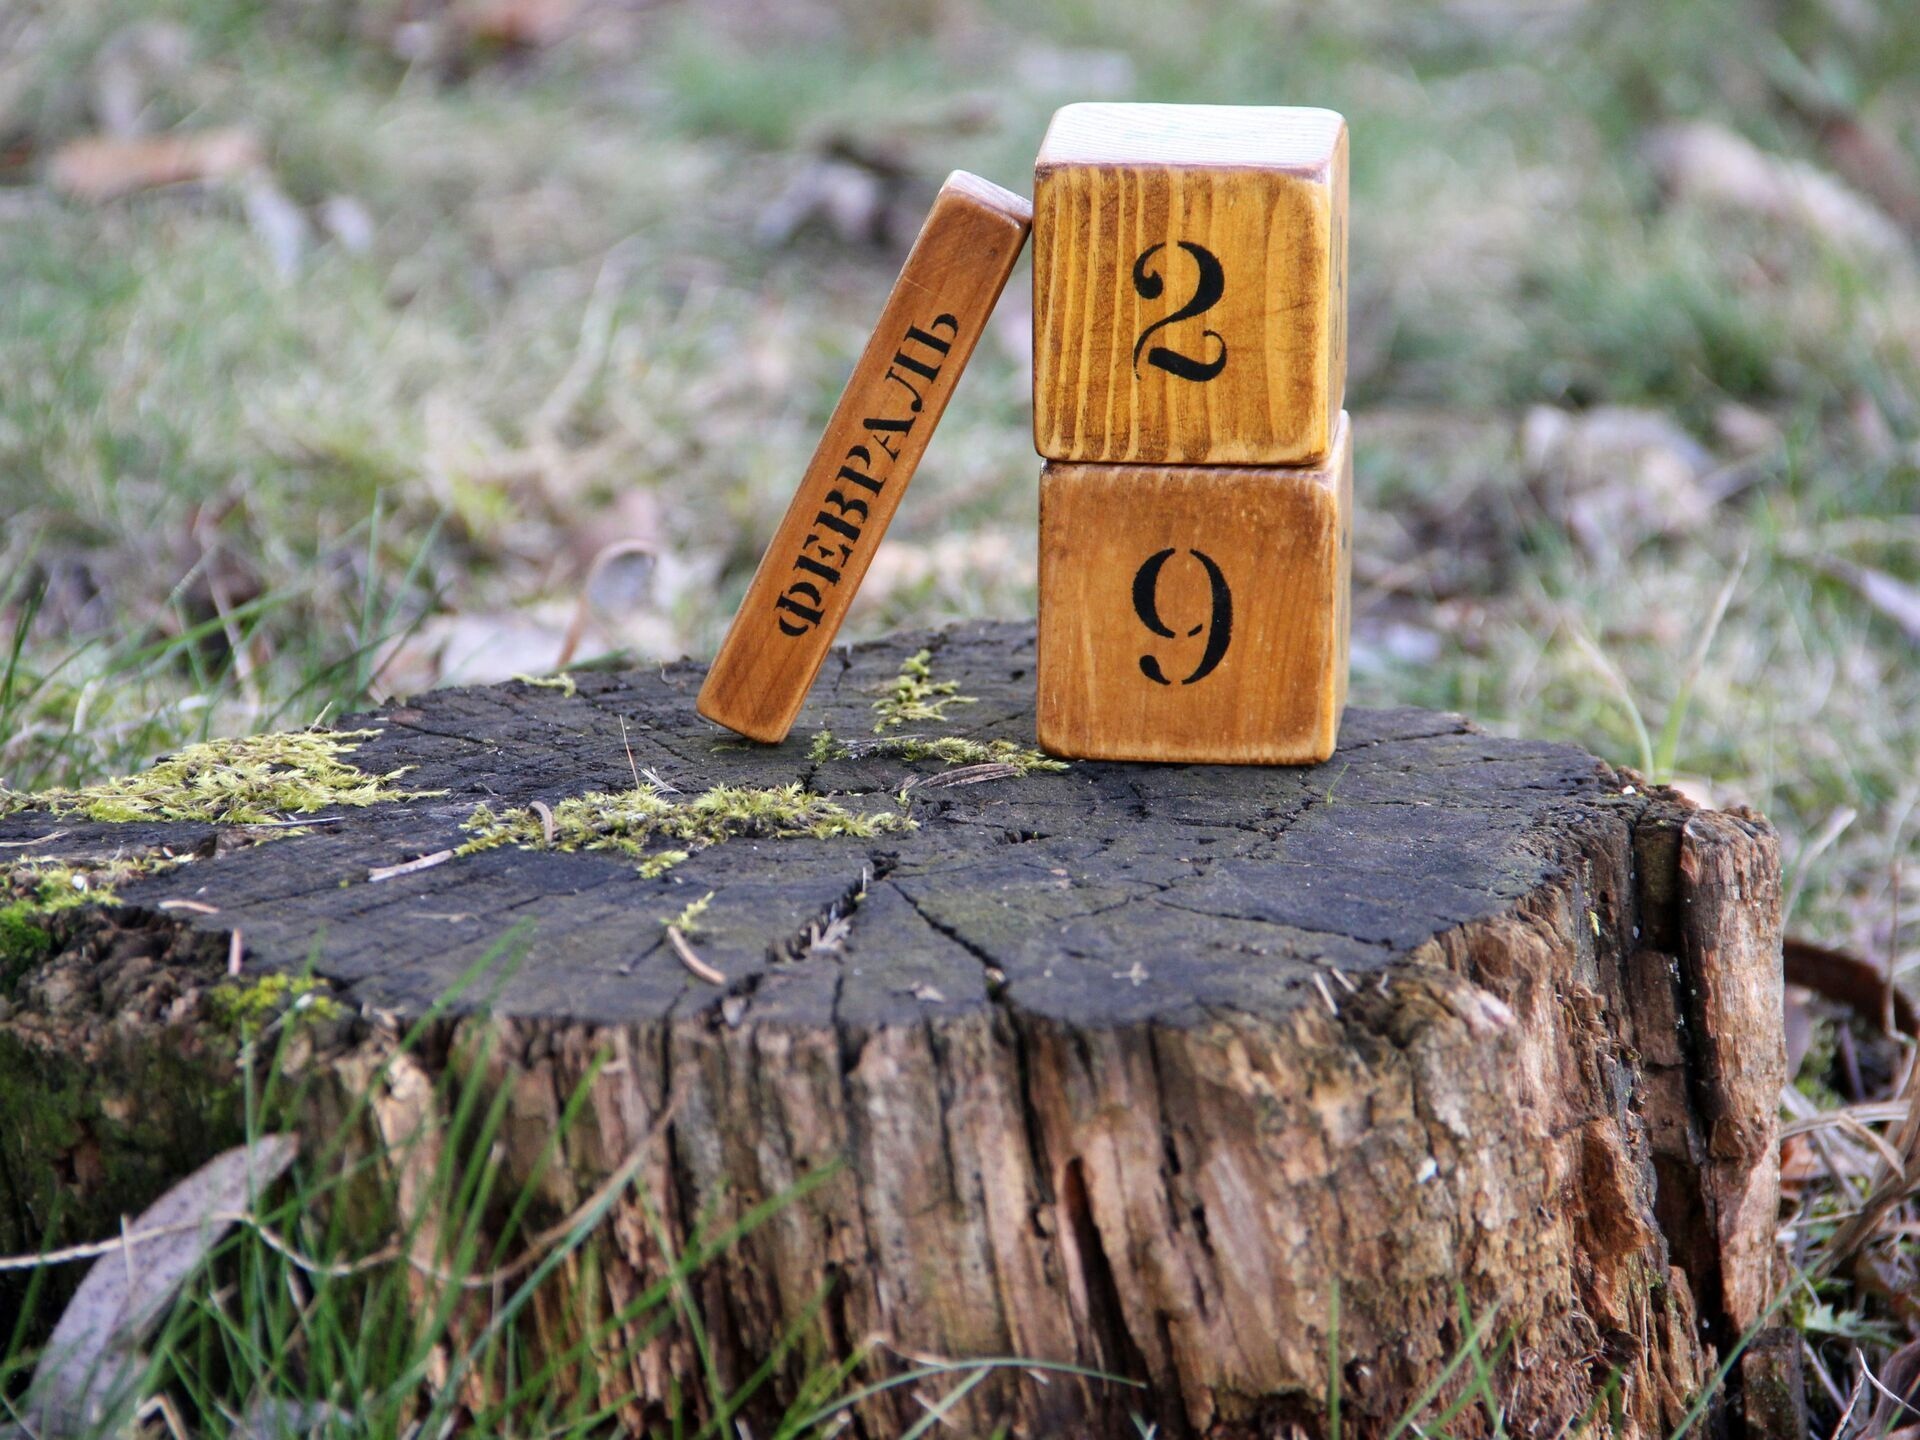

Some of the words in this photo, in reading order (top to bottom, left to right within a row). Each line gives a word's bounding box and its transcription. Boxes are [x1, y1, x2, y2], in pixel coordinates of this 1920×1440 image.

[1133, 242, 1227, 382] 2
[775, 313, 959, 638] ФЕВРАЛЬ
[1132, 548, 1232, 685] 9
